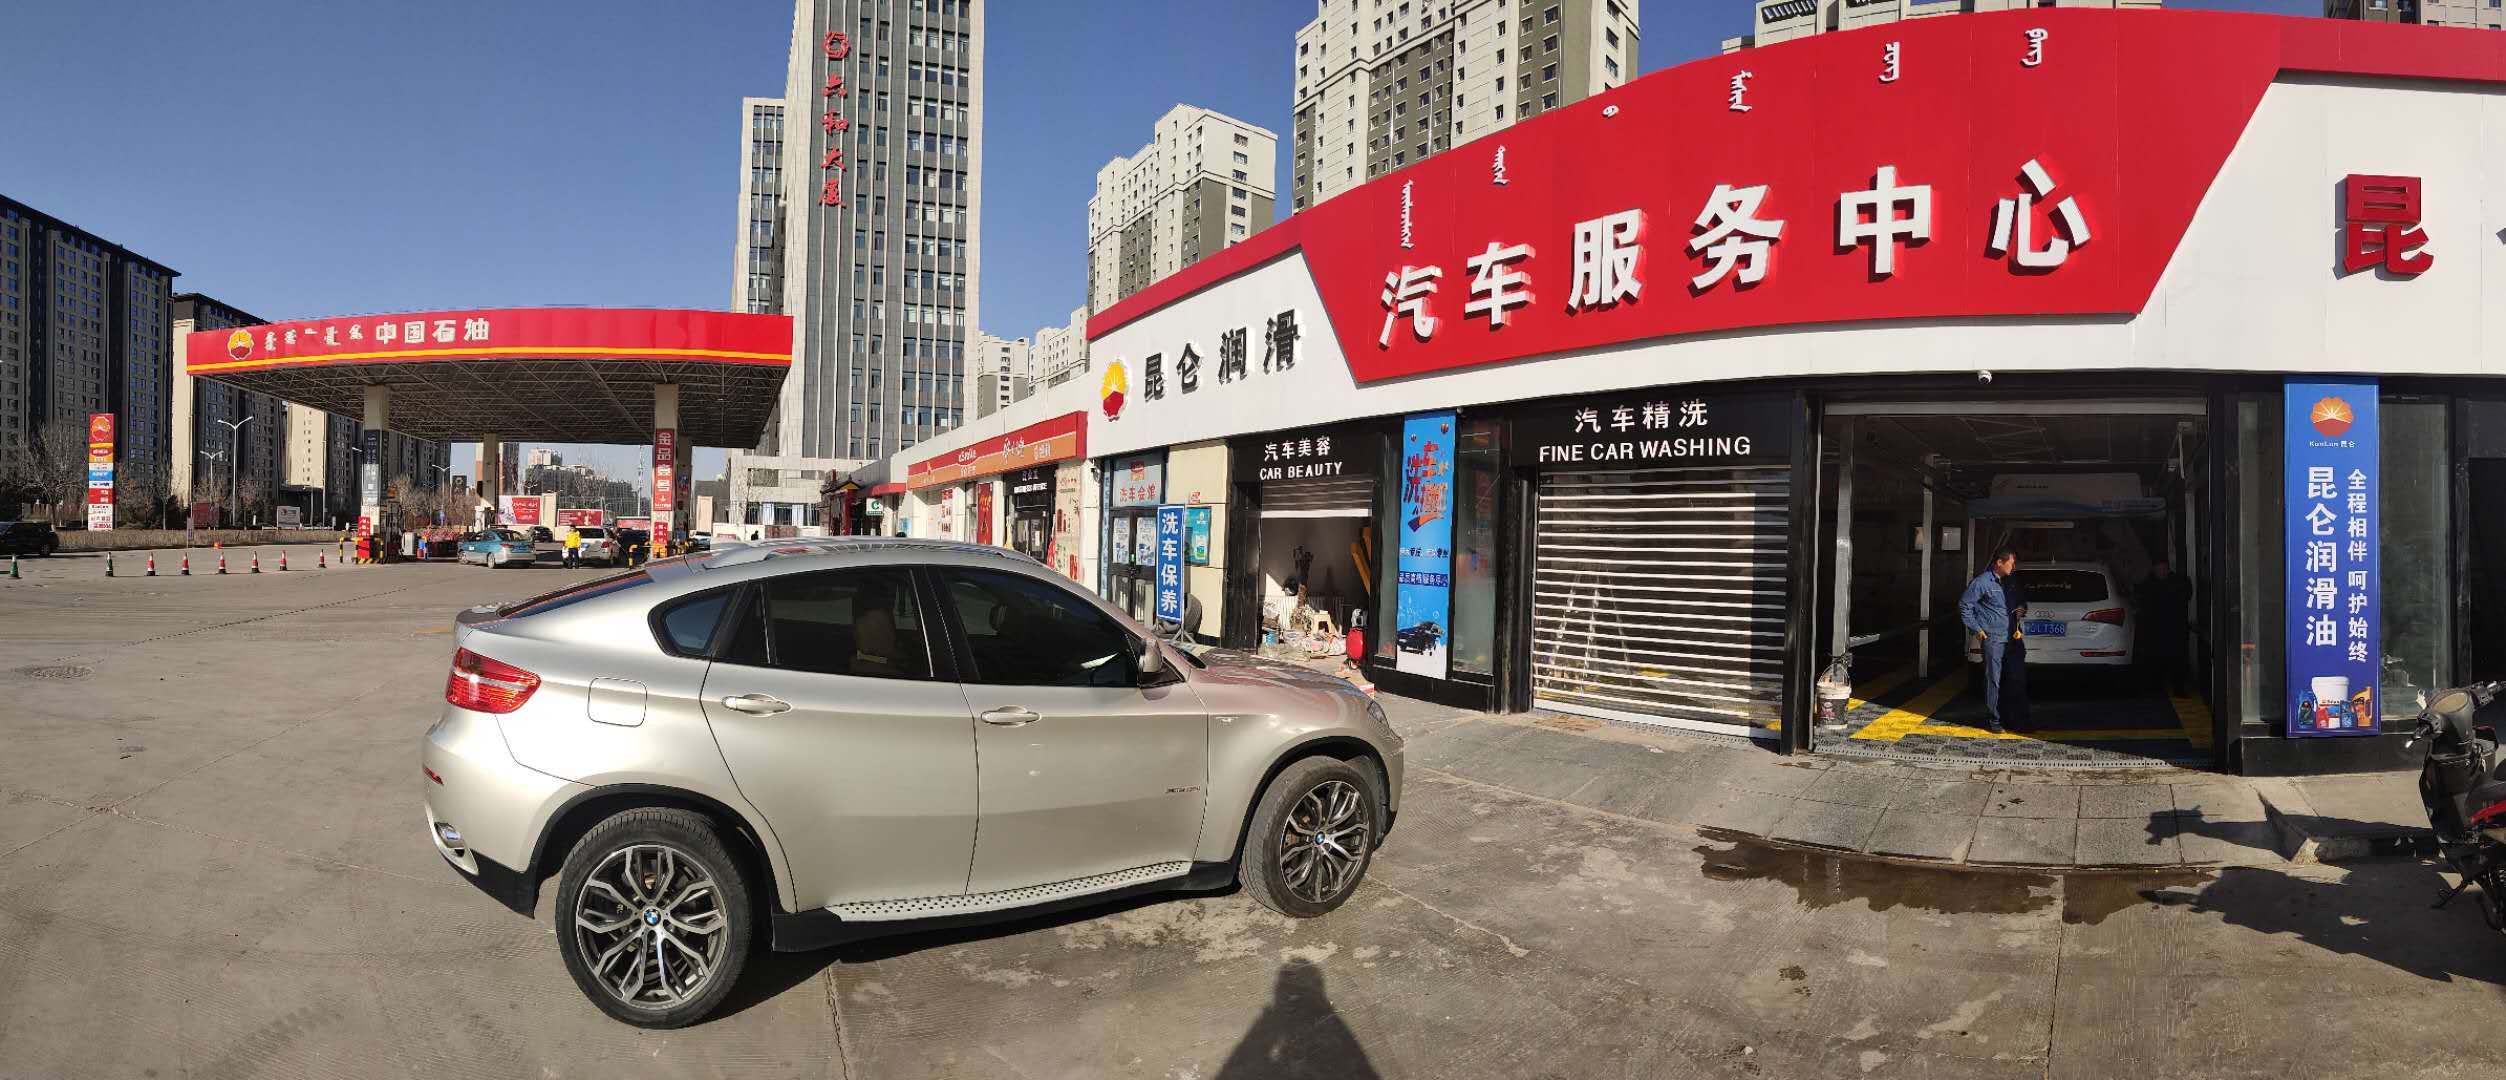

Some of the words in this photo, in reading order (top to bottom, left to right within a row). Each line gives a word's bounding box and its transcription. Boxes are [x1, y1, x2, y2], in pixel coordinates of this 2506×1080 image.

[1377, 157, 2093, 351] 汽车服务中心
[2342, 173, 2435, 275] 昆
[376, 318, 490, 345] 中国石油
[1143, 308, 1301, 402] 昆仑润滑
[1264, 435, 1331, 462] 汽车美容
[1539, 444, 1584, 463] FINE
[1590, 442, 1634, 461] CAR
[1639, 436, 1751, 459] WASHING
[1574, 398, 1708, 434] 汽车精洗
[1259, 467, 1282, 481] CAR
[1287, 461, 1343, 479] BEAUTY
[2347, 468, 2369, 562] 全程相伴
[1161, 512, 1179, 614] 洗车保养
[2305, 466, 2338, 648] 昆仑润滑油
[2347, 570, 2369, 662] 呵护始终
